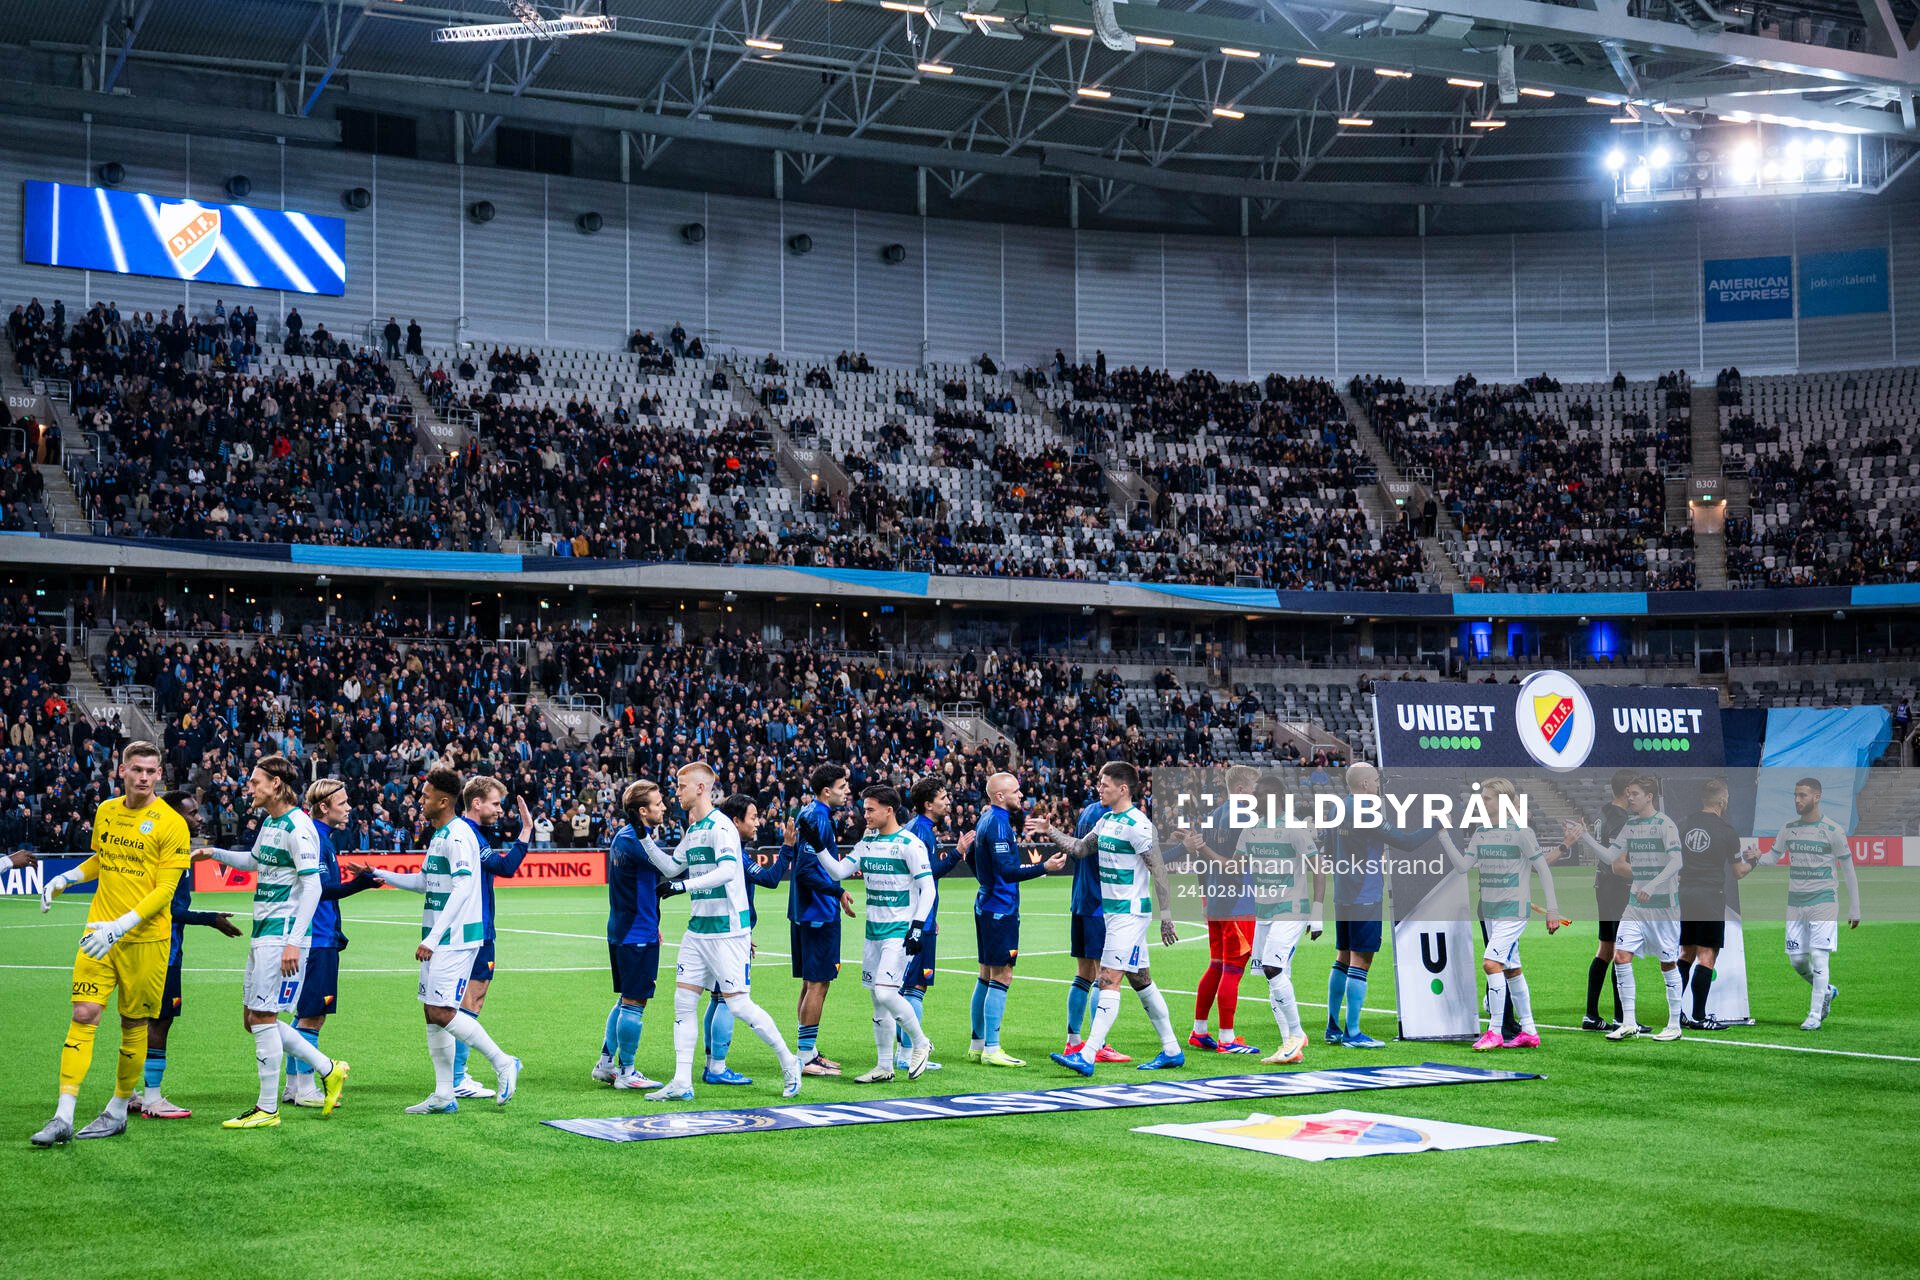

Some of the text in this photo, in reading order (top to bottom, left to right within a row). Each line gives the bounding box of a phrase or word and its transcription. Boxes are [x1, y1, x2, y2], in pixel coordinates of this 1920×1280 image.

[172, 215, 213, 252] D.I.F.
[1708, 276, 1788, 291] AMERICAN
[1810, 273, 1877, 290] jobandtalent
[1719, 288, 1790, 302] EXPRESS
[9, 396, 37, 408] B307
[430, 425, 454, 437] B306
[1696, 479, 1718, 489] B302
[92, 706, 122, 719] A107
[1397, 704, 1496, 732] UNIBET
[1543, 702, 1571, 735] D.I.F.
[1613, 707, 1703, 734] UNIBET
[109, 835, 145, 850] Telexia
[1687, 830, 1708, 851] MG
[1483, 848, 1508, 857] Telexia
[1796, 844, 1823, 853] Telexia
[121, 866, 145, 877] Energy
[869, 862, 894, 871] Telexia
[1420, 932, 1448, 974] U
[771, 1066, 1490, 1125] ALLSVENSKAN
